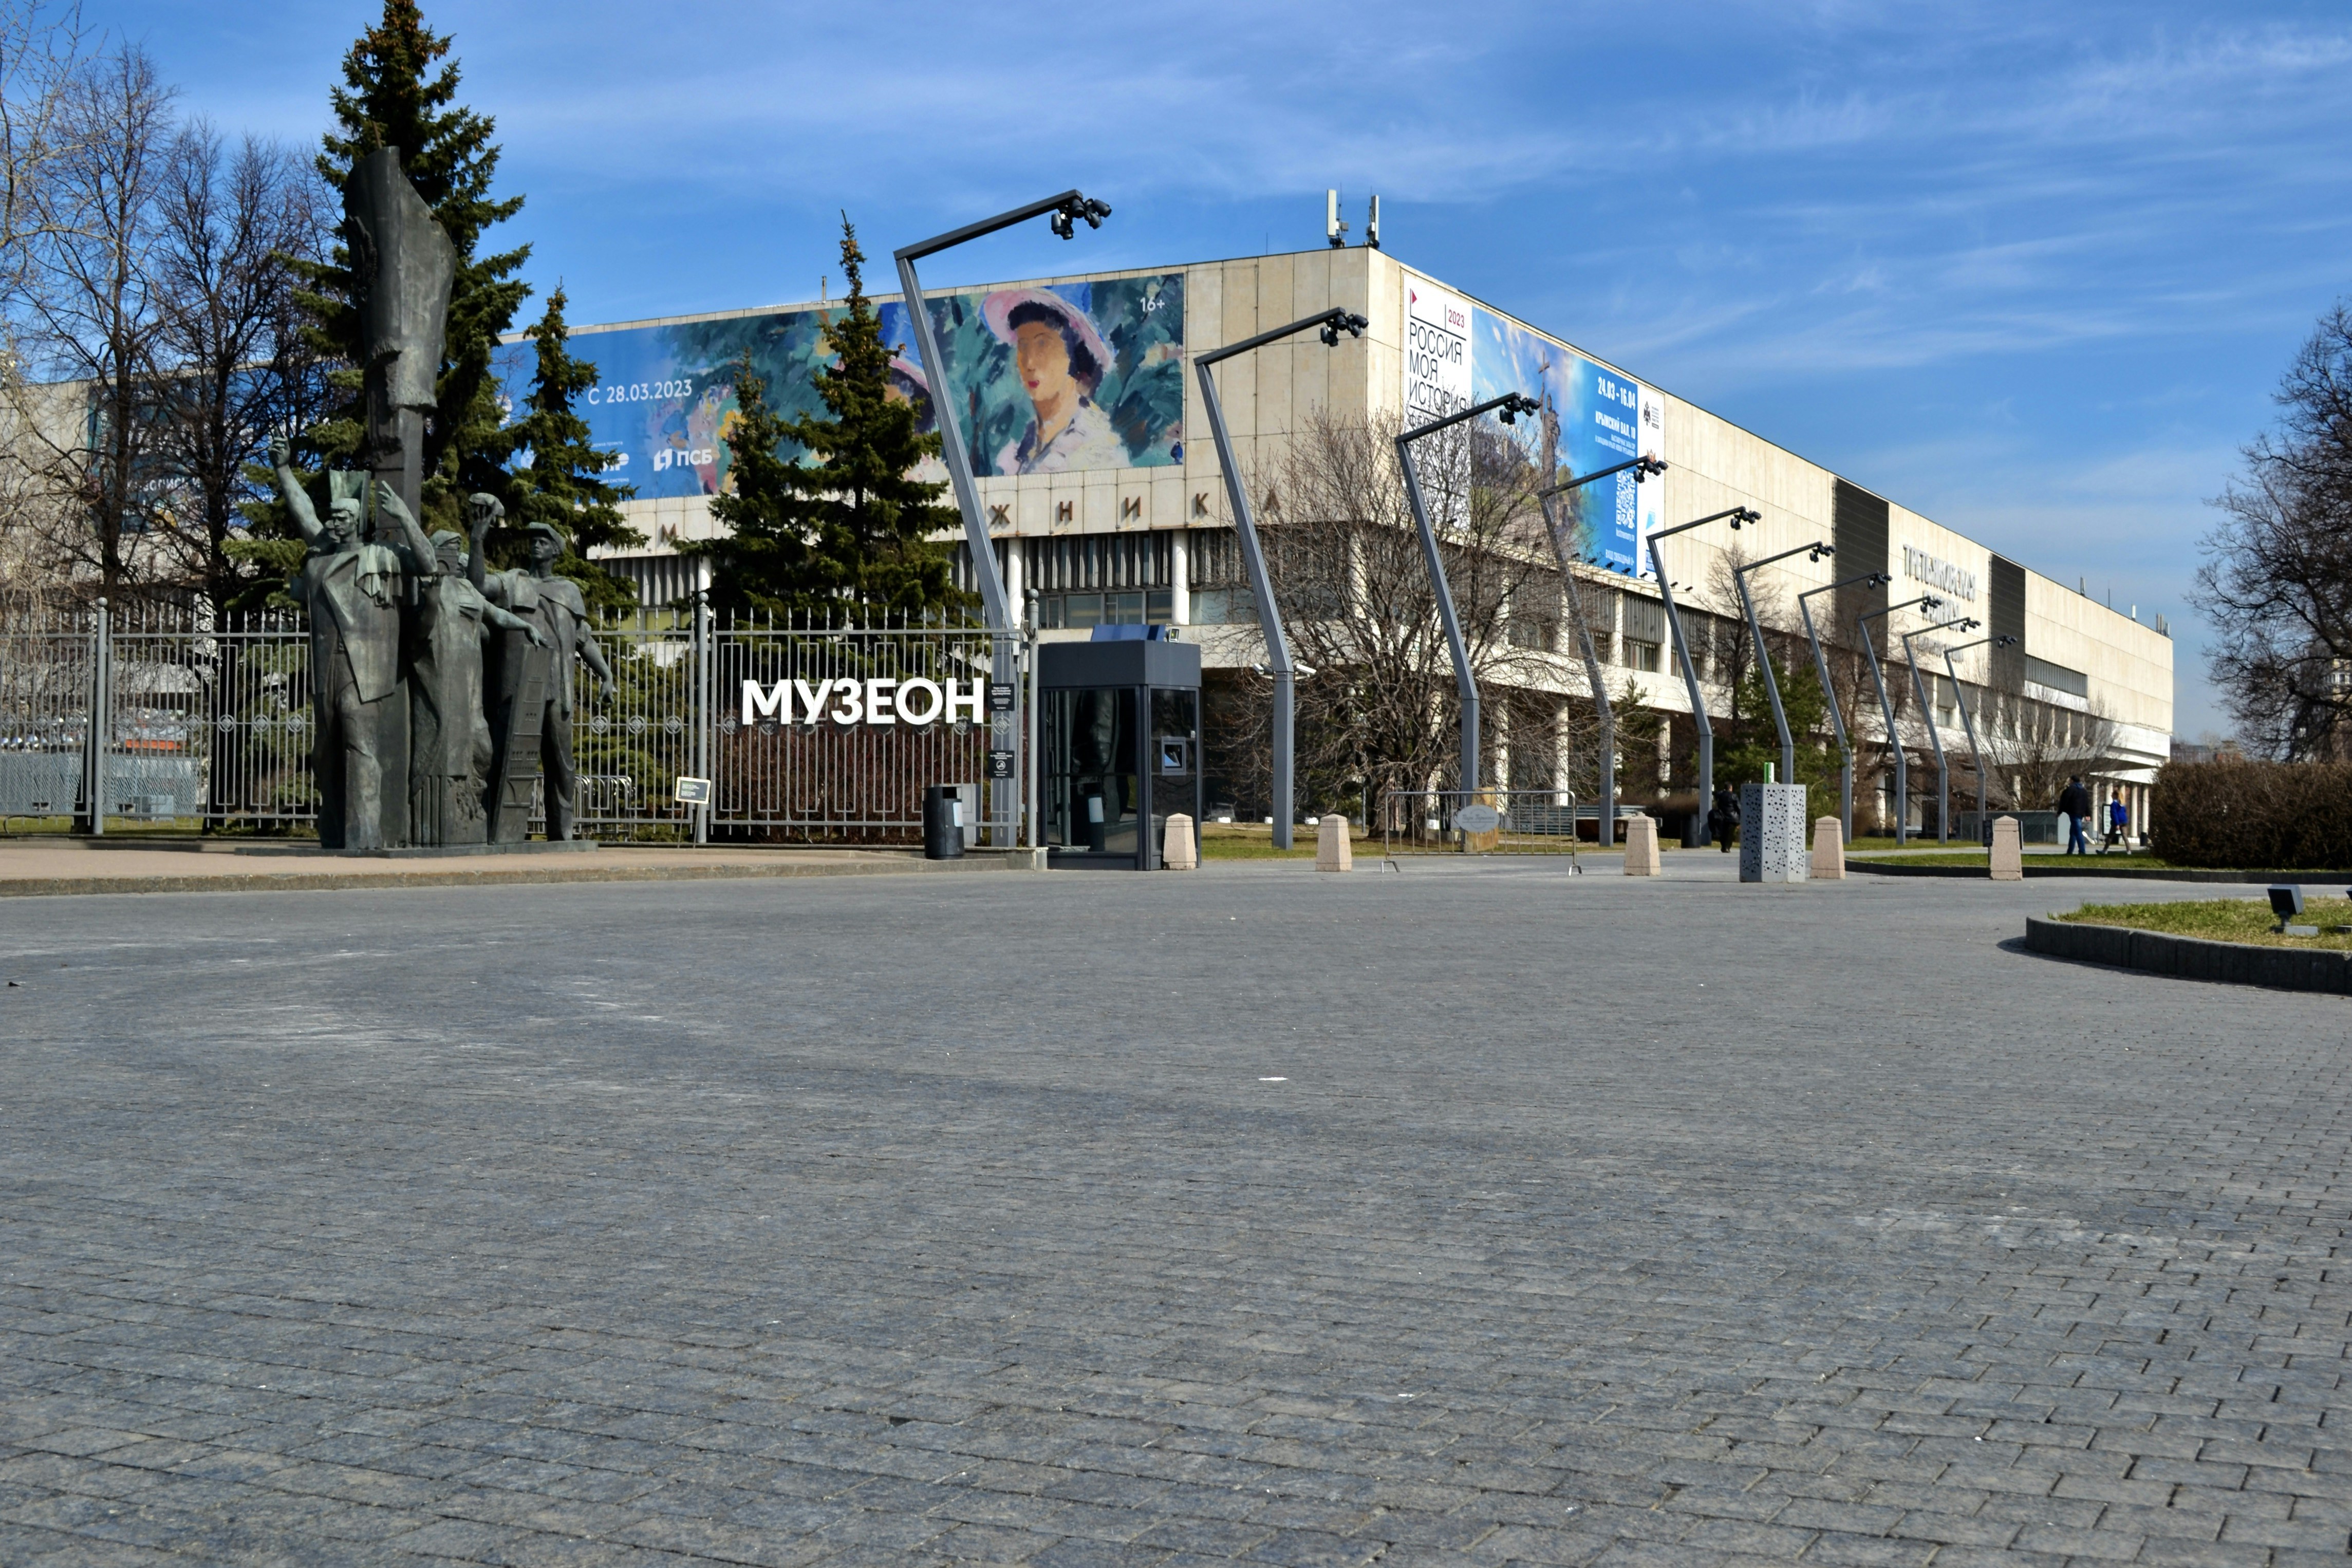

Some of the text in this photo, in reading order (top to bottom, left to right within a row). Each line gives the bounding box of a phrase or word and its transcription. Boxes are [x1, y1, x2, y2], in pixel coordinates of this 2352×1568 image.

[1140, 296, 1165, 312] 16+
[1448, 309, 1465, 328] 2023
[1409, 321, 1462, 365] РОССИЯ
[1409, 349, 1438, 383] МОЯ
[588, 379, 692, 405] С 28.03.2023
[1409, 377, 1467, 415] ИСТОРИЯ
[1598, 376, 1615, 401] 24.03
[1620, 387, 1636, 410] 16.04
[1595, 410, 1620, 433] КРЫМСКИЙ
[677, 449, 713, 466] ПСБ
[742, 677, 984, 725] МУЗЕОН
